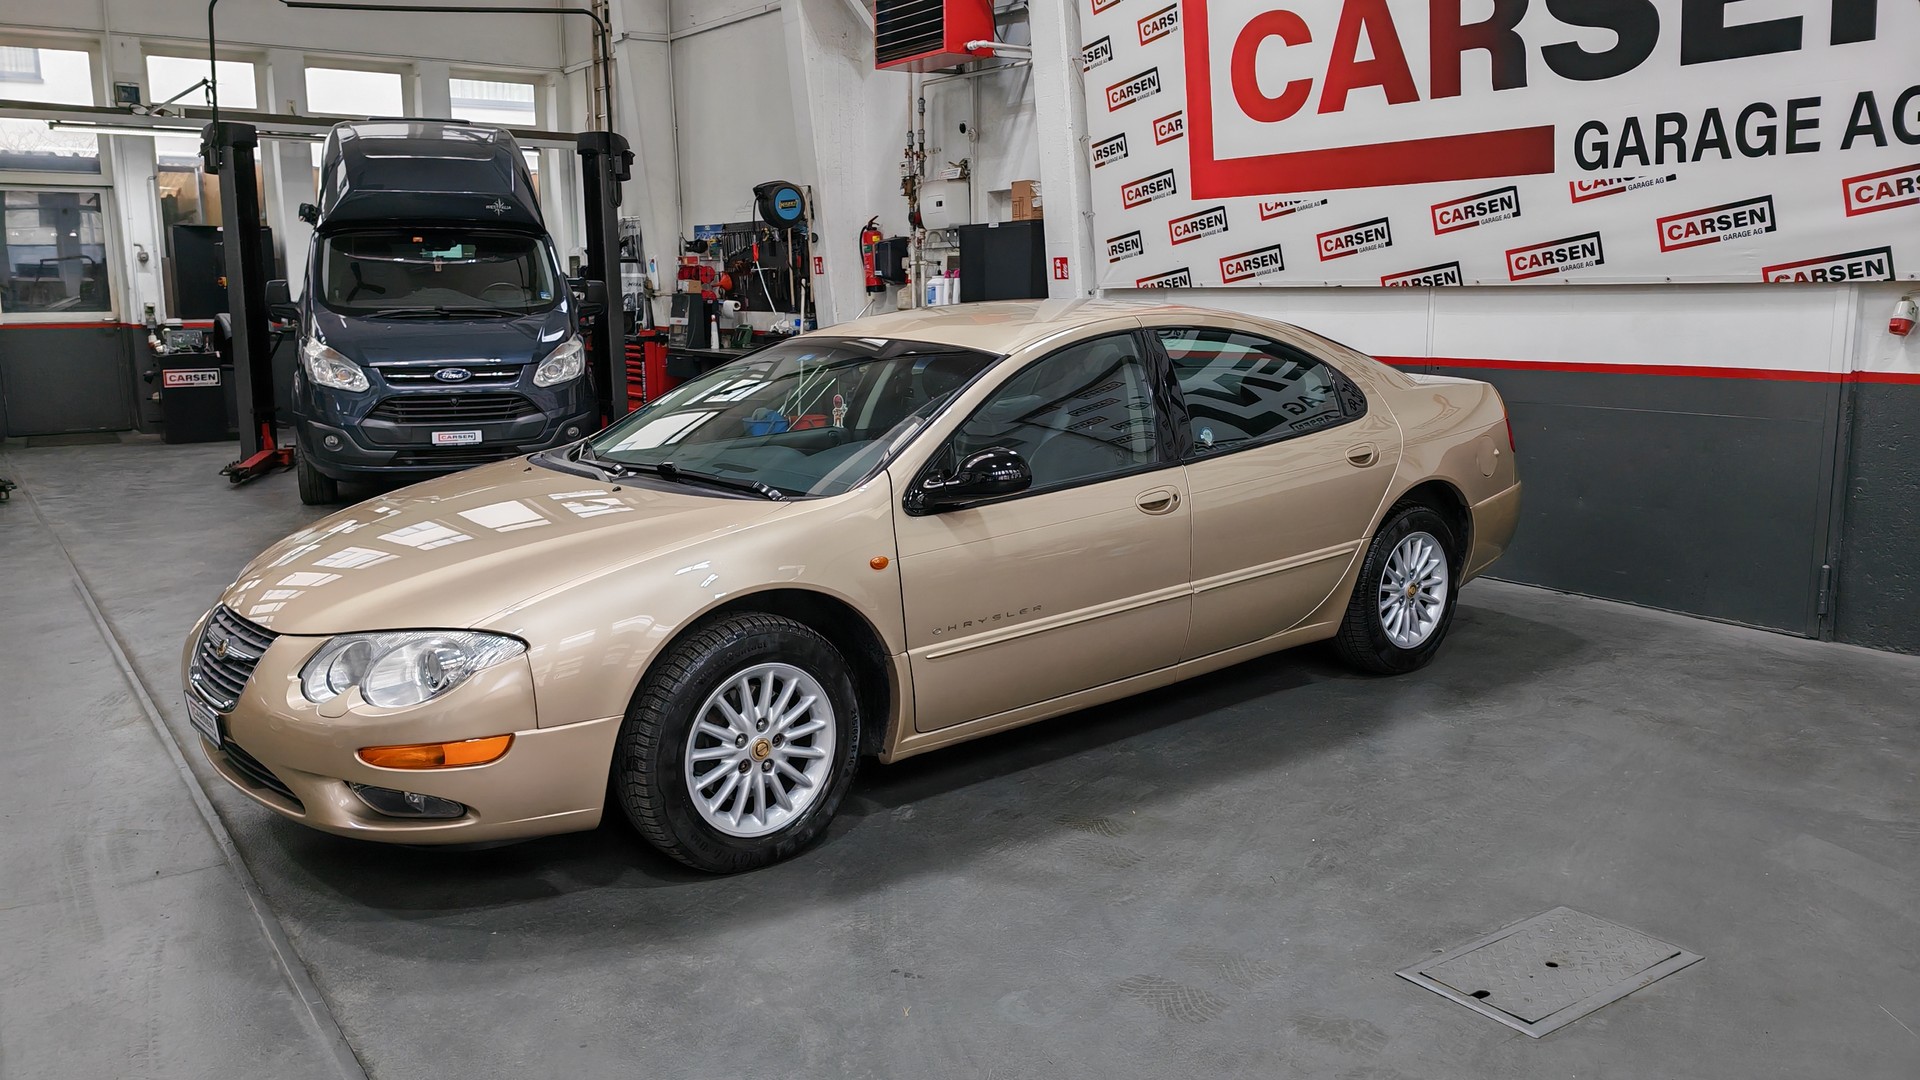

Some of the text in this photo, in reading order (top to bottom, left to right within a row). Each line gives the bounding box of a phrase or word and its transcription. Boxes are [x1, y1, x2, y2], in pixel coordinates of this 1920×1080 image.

[1111, 76, 1156, 103] CARSEN
[1158, 118, 1183, 137] CAR
[1574, 85, 1920, 171] GARAGE AG
[1126, 177, 1172, 201] CARSEN
[1628, 179, 1654, 191] GARAGE
[1855, 175, 1920, 203] CAR
[1439, 195, 1513, 225] CARSEN
[1481, 216, 1502, 225] GARAGE
[1174, 213, 1223, 237] CARSEN
[1667, 207, 1767, 241] CARSEN
[1723, 229, 1751, 241] GARAGE
[1323, 226, 1386, 252] CARSEN
[1225, 253, 1279, 275] CARSEN
[1514, 242, 1596, 271] CARSEN
[1560, 262, 1584, 272] GARAGE
[169, 373, 216, 382] CARSEN
[932, 605, 1042, 635] CHRYSLER
